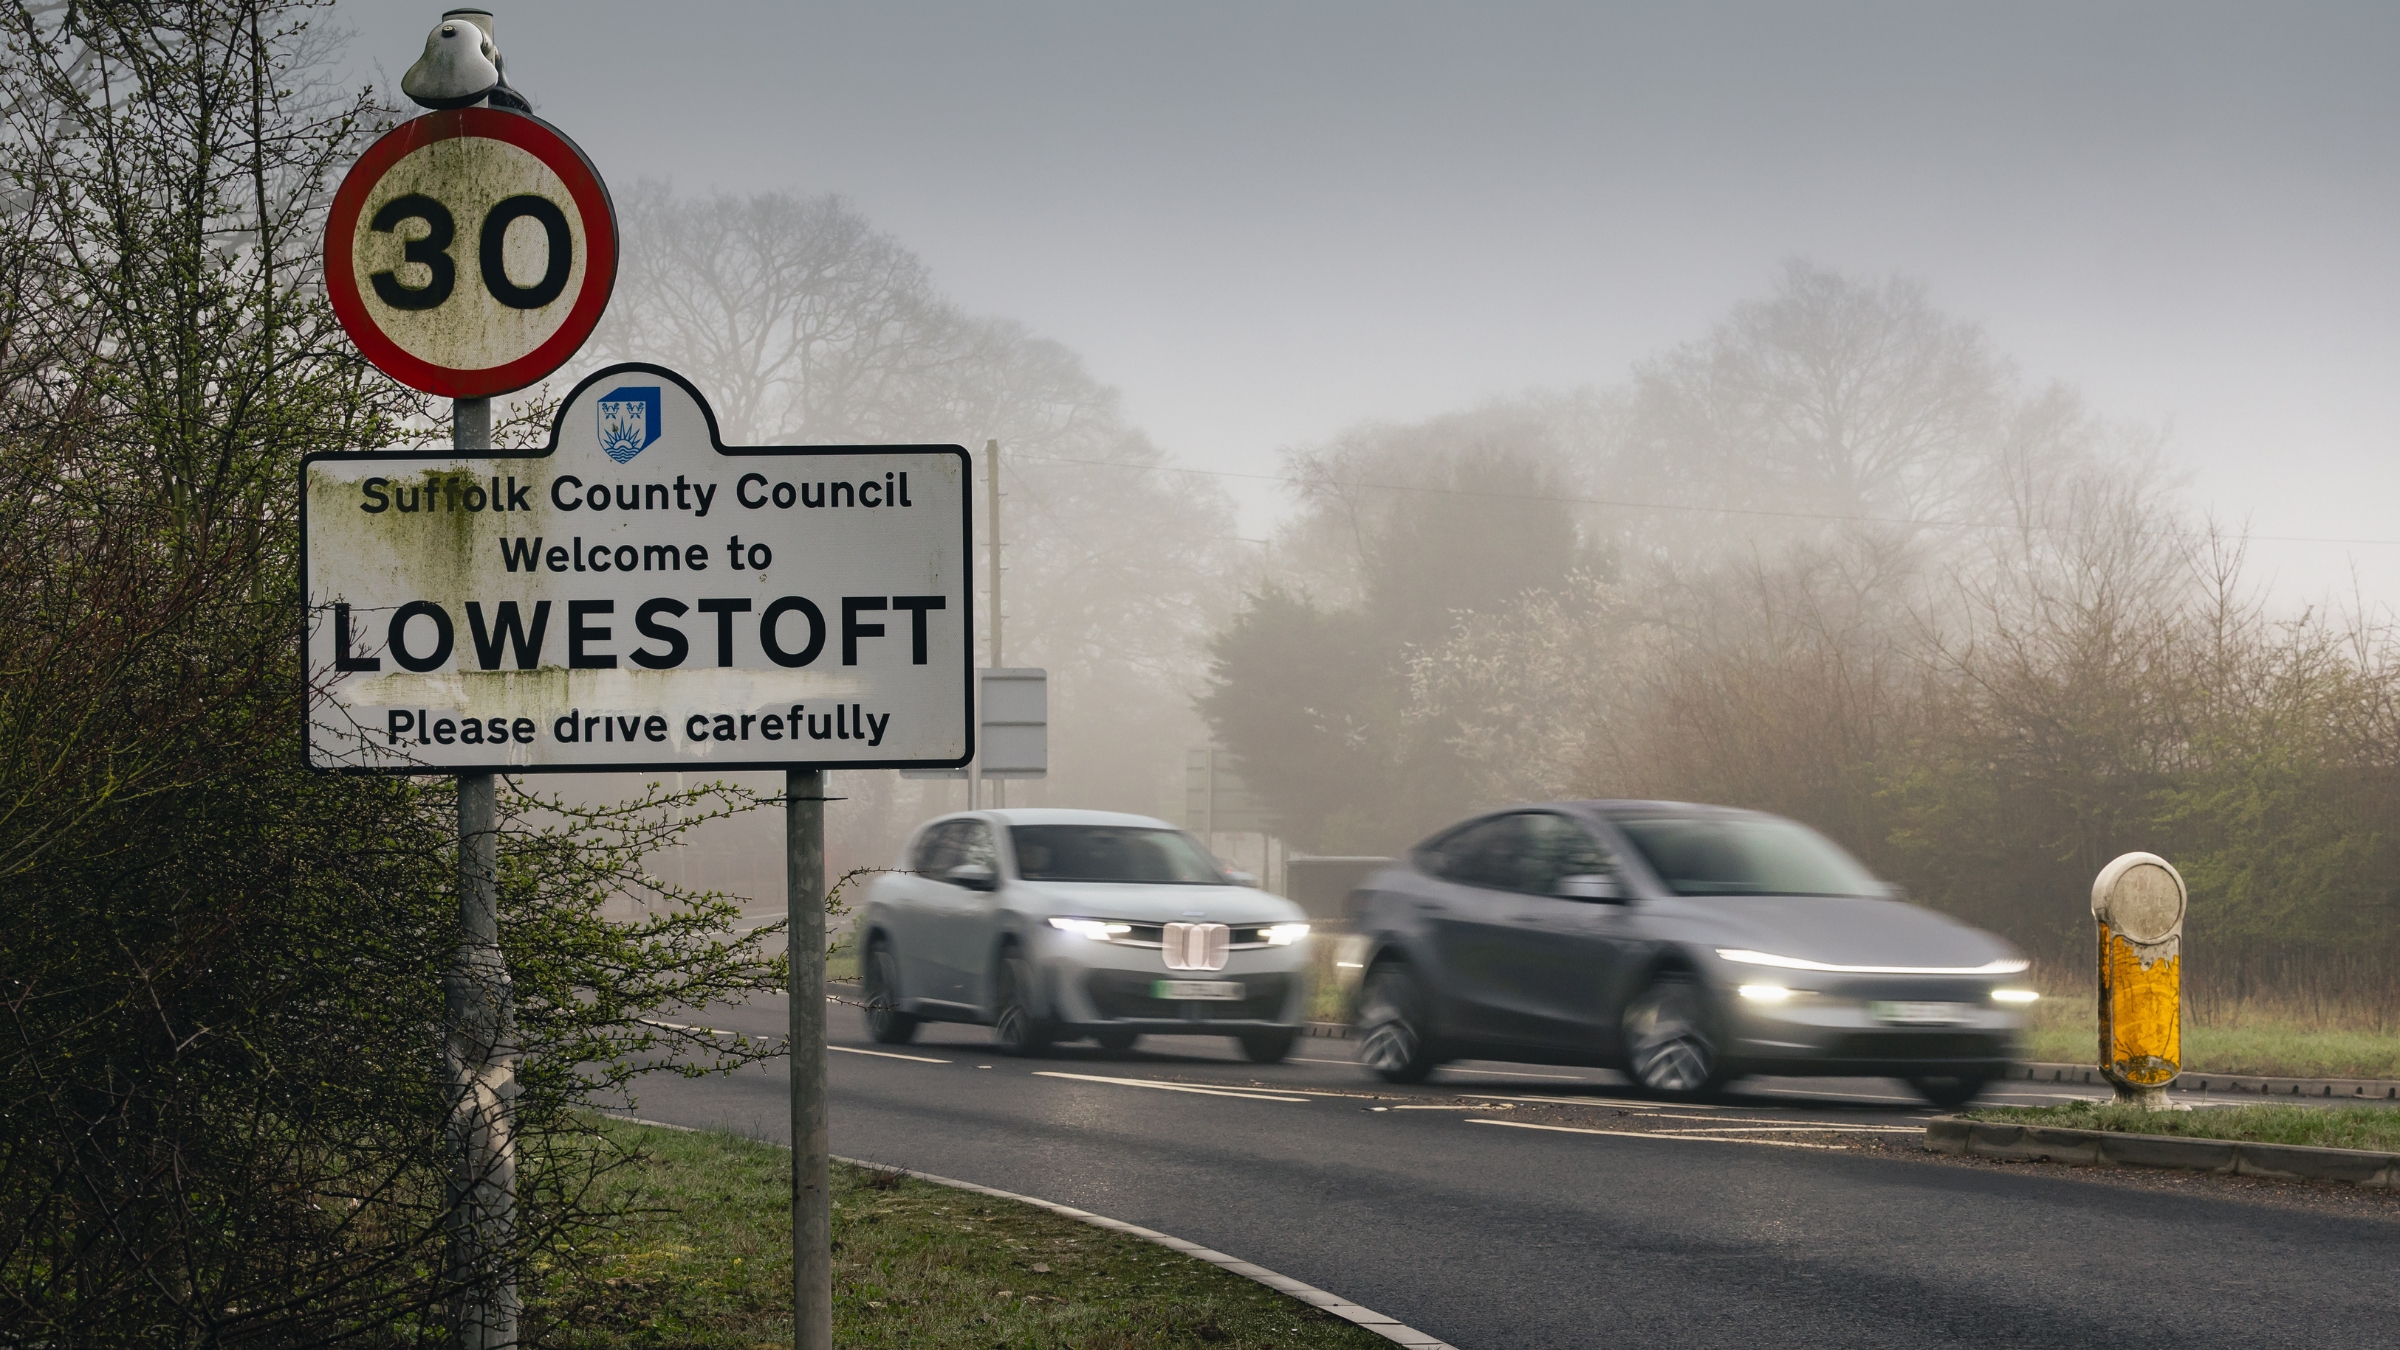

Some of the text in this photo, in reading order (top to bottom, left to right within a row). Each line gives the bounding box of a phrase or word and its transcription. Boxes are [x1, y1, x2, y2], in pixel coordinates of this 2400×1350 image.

[370, 192, 572, 310] 30
[360, 472, 912, 517] Suffolk County Council
[499, 535, 772, 573] Welcome to
[334, 595, 946, 672] LOWESTOFT
[388, 704, 891, 747] Please drive carefully
